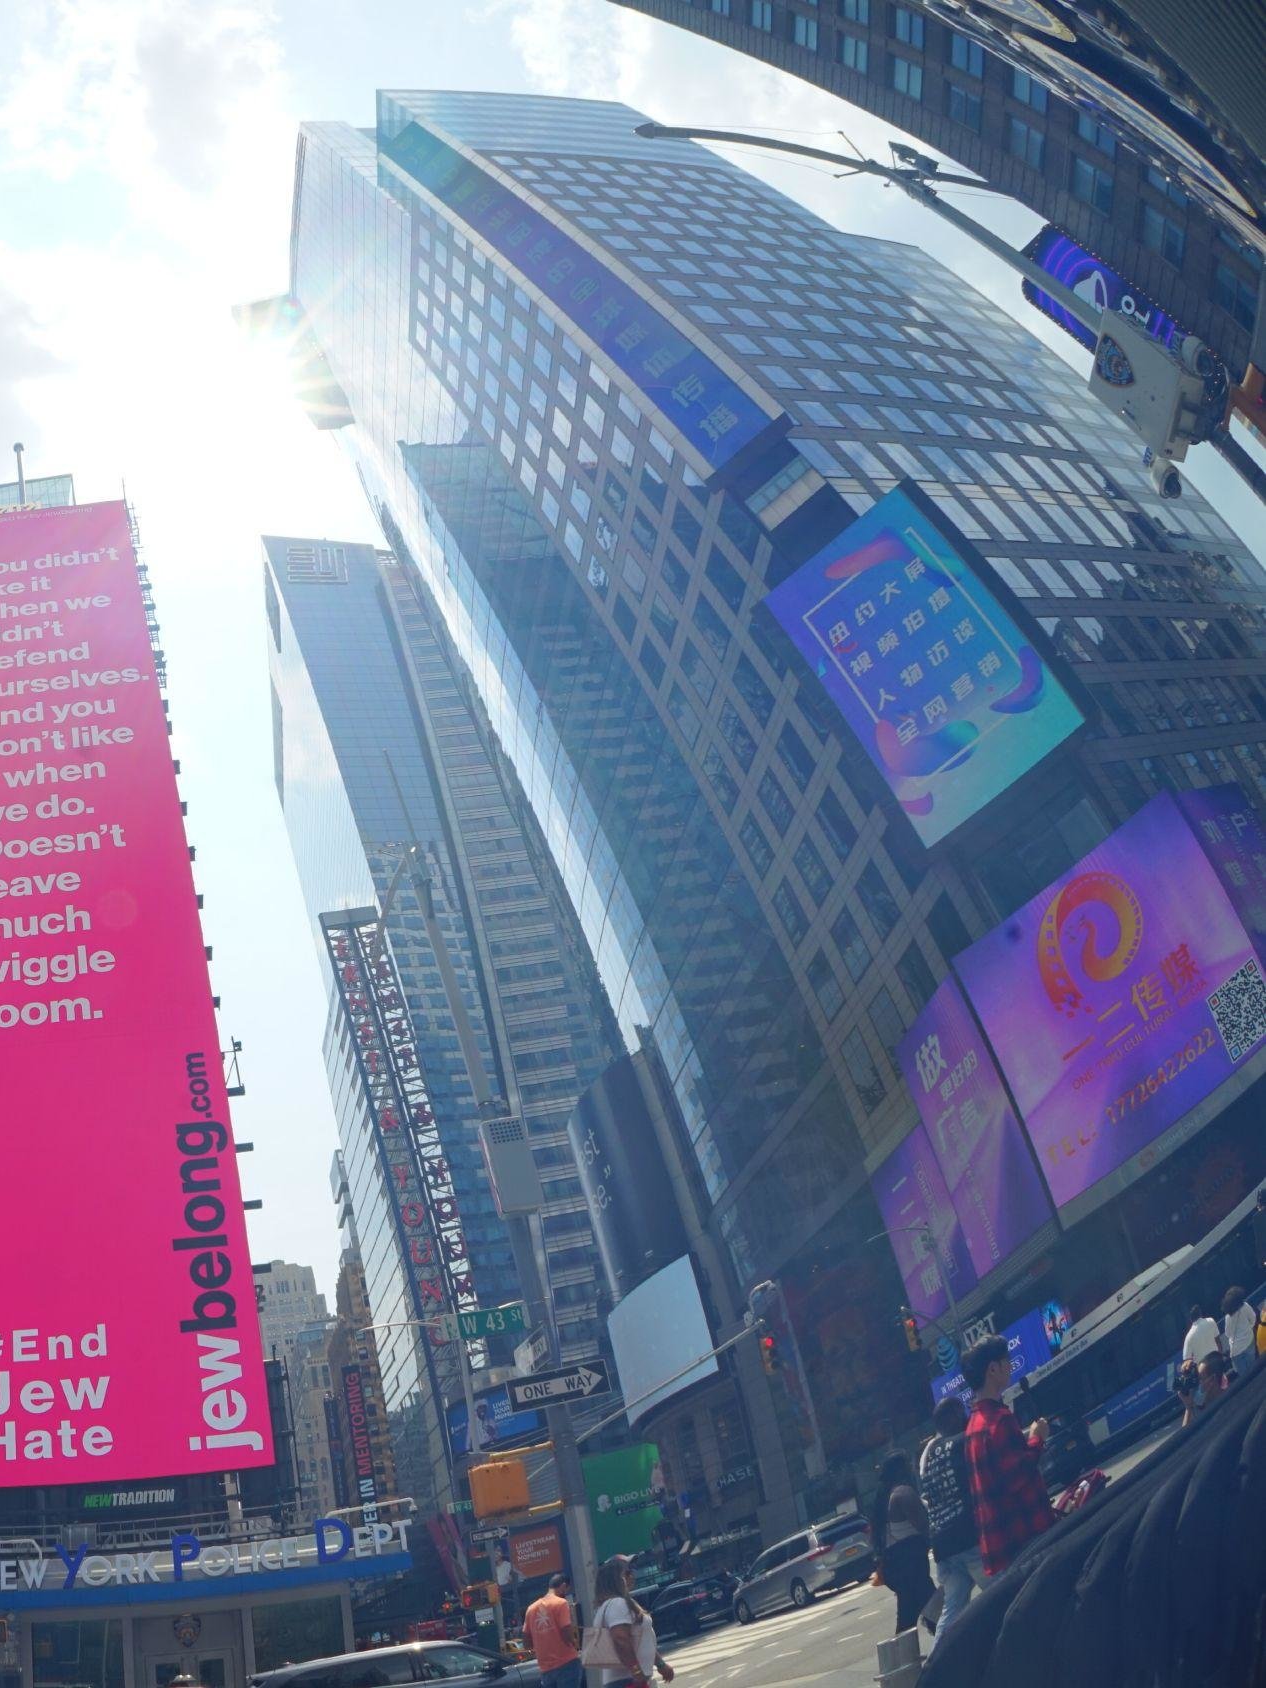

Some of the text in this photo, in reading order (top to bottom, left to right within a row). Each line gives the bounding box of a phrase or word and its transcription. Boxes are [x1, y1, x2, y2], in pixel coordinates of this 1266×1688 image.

[33, 548, 120, 570] didn't
[31, 576, 52, 592] it
[65, 595, 112, 611] we
[50, 698, 116, 725] you
[71, 726, 135, 748] like
[3, 761, 107, 788] when
[35, 794, 95, 819] do.
[1063, 942, 1201, 1061] 一二传媒
[173, 1052, 264, 1452] jewbelong.com
[462, 1317, 477, 1335] W
[486, 1312, 506, 1331] 43
[523, 1372, 595, 1400] ONE WAY
[346, 1372, 373, 1476] MENTORING
[359, 1478, 375, 1498] IN
[614, 1490, 640, 1505] BIGO
[55, 1543, 160, 1590] YORK
[173, 1533, 301, 1582] POLICE
[315, 1518, 413, 1564] DEPT
